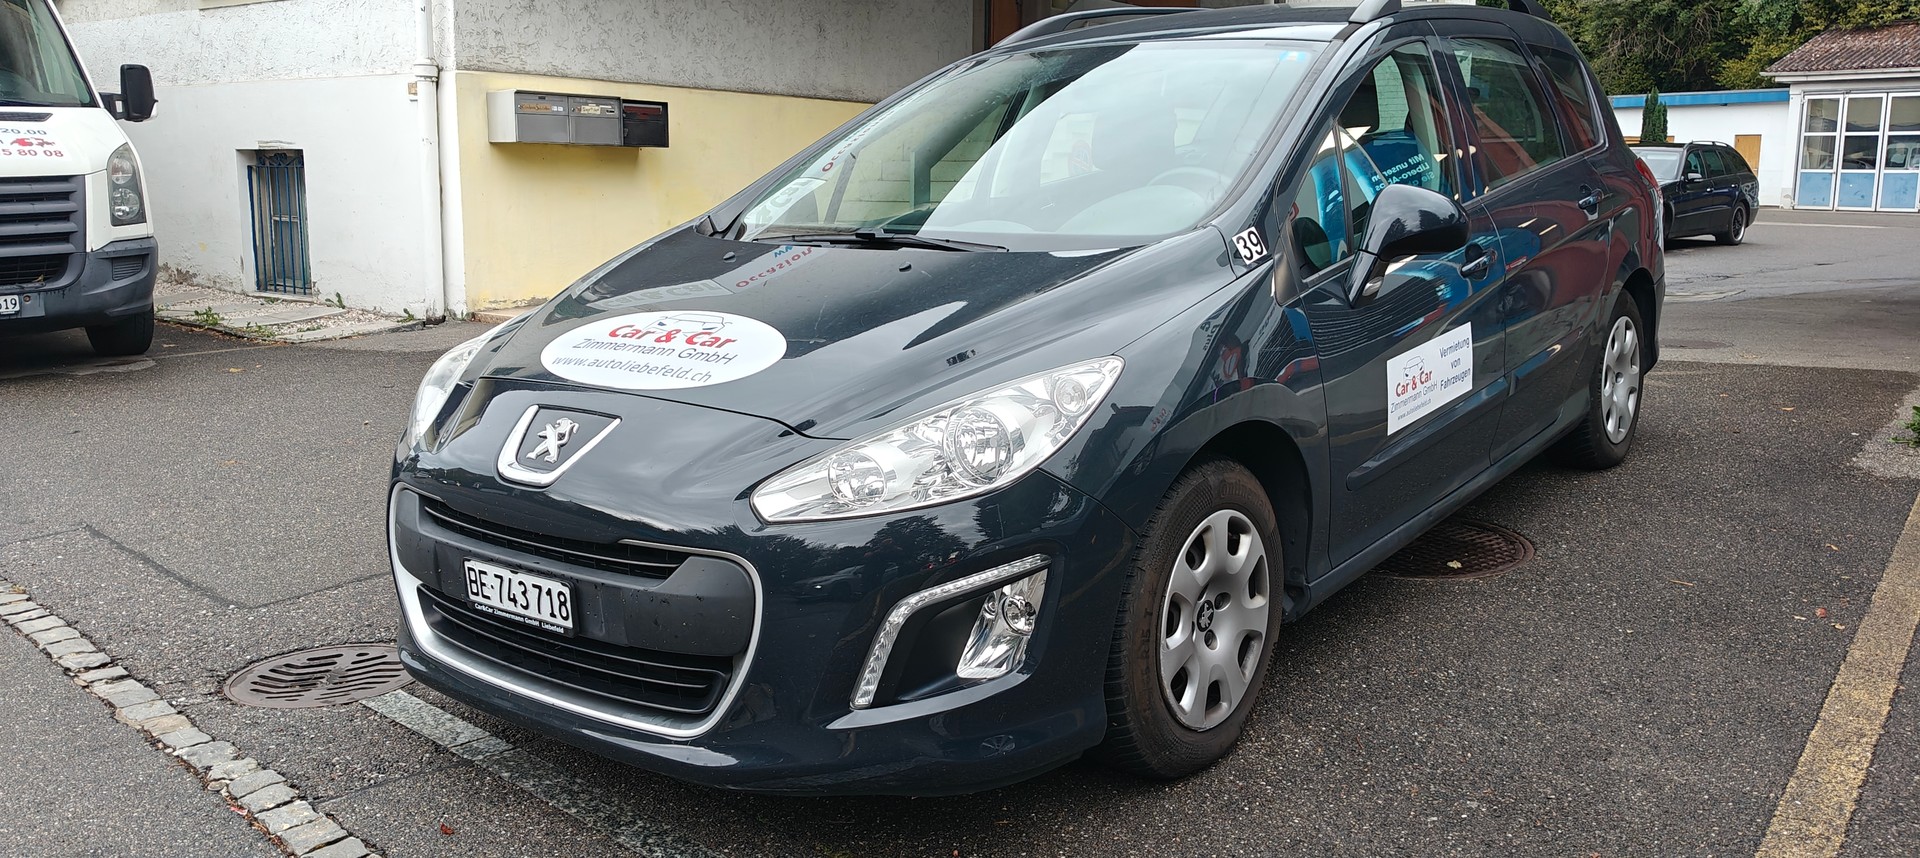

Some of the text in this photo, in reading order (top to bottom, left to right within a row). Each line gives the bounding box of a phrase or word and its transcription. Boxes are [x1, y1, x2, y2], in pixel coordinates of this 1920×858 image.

[17, 149, 38, 157] 80
[43, 149, 64, 158] 08
[1236, 230, 1264, 261] 39
[0, 298, 17, 310] 19
[608, 324, 737, 349] Car & Car
[1439, 337, 1470, 359] Vermietung
[572, 338, 739, 365] Zimmermann GmbH
[1450, 357, 1462, 369] von
[552, 355, 713, 384] www.autoliebefeld.ch
[1439, 367, 1471, 392] Fahrzeugen
[1395, 369, 1433, 398] Car & Car
[1390, 380, 1438, 414] Zimmermann GmbH
[493, 608, 524, 623] Zimmermann
[524, 617, 540, 627] GmbH
[541, 622, 564, 634] Liebefeld
